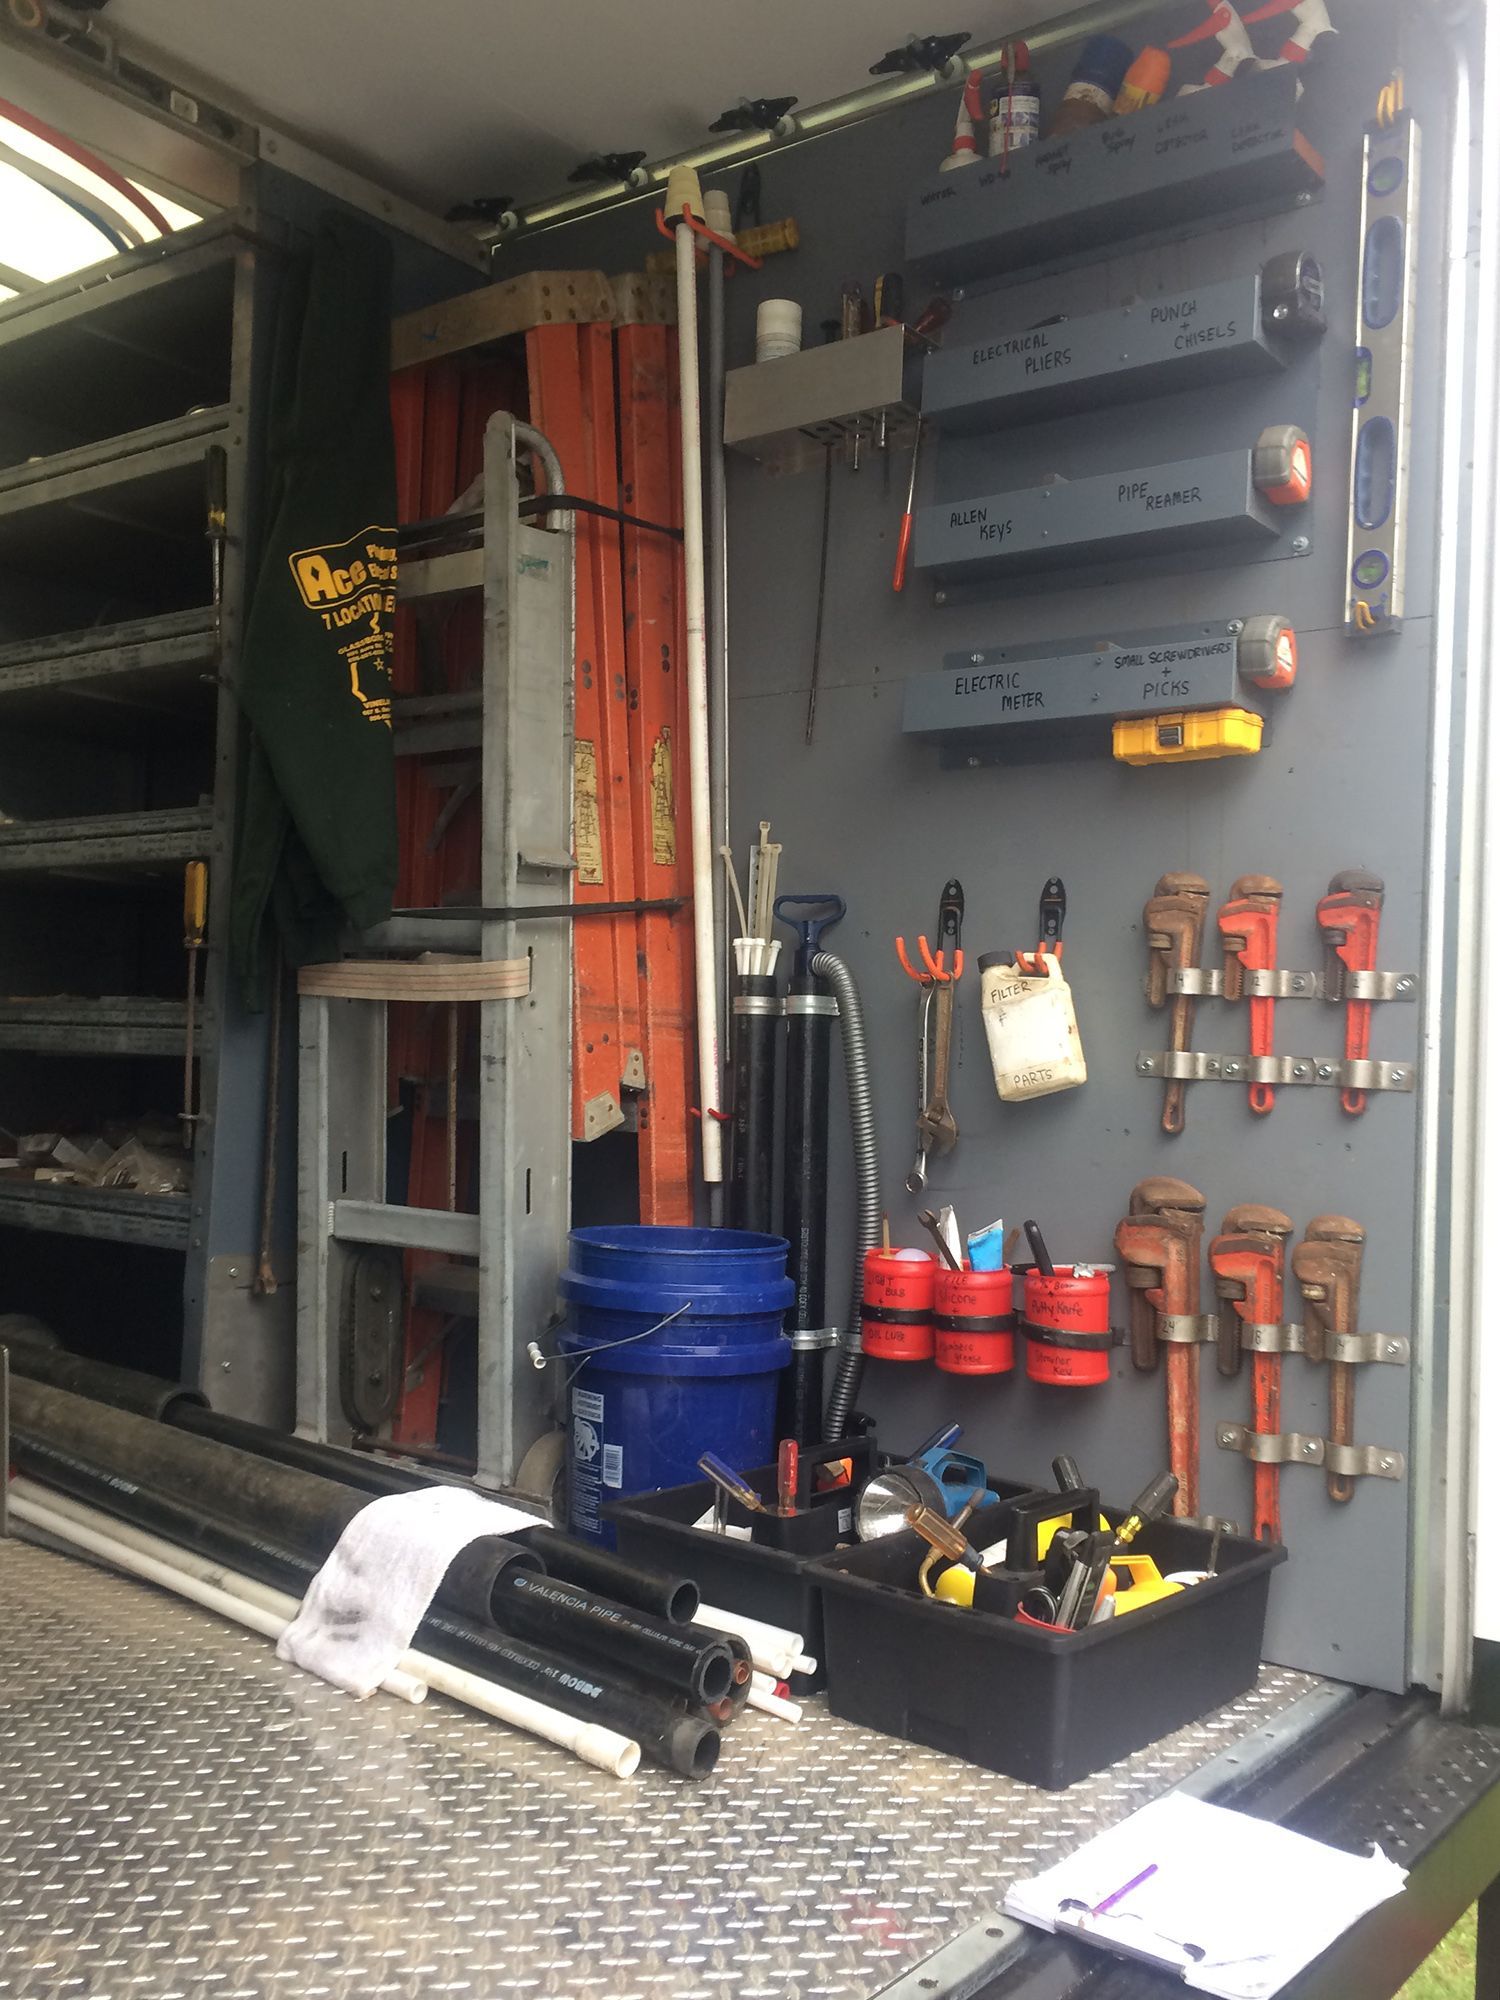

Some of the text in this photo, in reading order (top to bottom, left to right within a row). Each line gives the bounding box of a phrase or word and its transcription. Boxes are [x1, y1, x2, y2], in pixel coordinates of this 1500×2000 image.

[1151, 300, 1197, 324] PUNCH
[1174, 321, 1236, 350] CHISELS
[973, 333, 1049, 365] ELECTRICAL
[1025, 348, 1071, 375] PLIERS
[1118, 482, 1149, 502] PIPE
[1145, 487, 1202, 511] REAMER
[950, 508, 987, 528] ALLEN
[980, 520, 1013, 542] KEYS
[321, 613, 332, 631] 7
[1114, 641, 1232, 669] SMALL SCREWDRIVERS
[955, 672, 1021, 695] ELECTRIC
[1143, 680, 1190, 700] PICKS
[1001, 692, 1045, 712] METER
[990, 981, 1032, 1003] FILTER
[1013, 1069, 1053, 1089] PARTS
[527, 1582, 588, 1612] VALENCIA
[590, 1605, 623, 1624] PIPE
